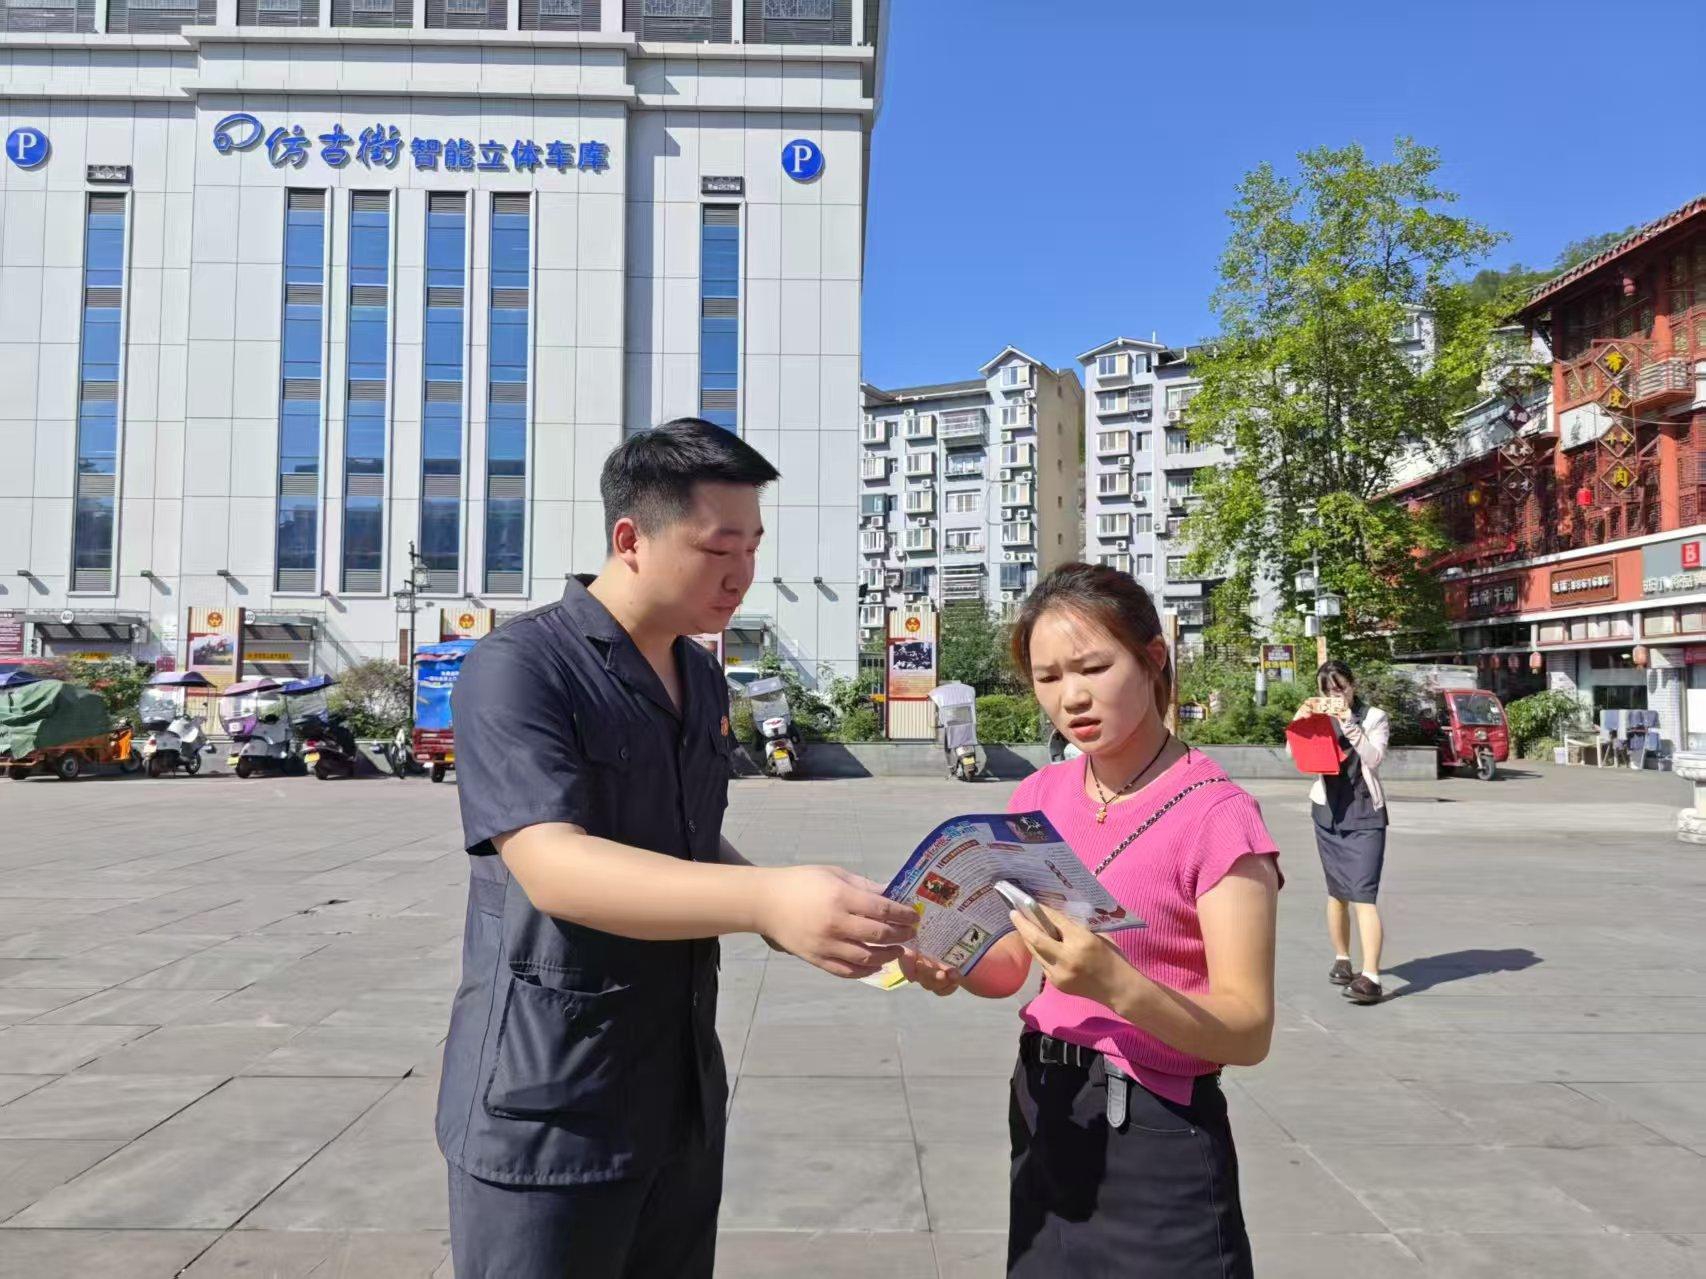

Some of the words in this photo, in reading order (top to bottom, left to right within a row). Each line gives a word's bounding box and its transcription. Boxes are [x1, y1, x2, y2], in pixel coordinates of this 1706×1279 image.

[16, 132, 37, 159] P
[265, 122, 402, 170] 仿古街
[411, 137, 610, 174] 智能立体车库
[791, 145, 813, 173] P
